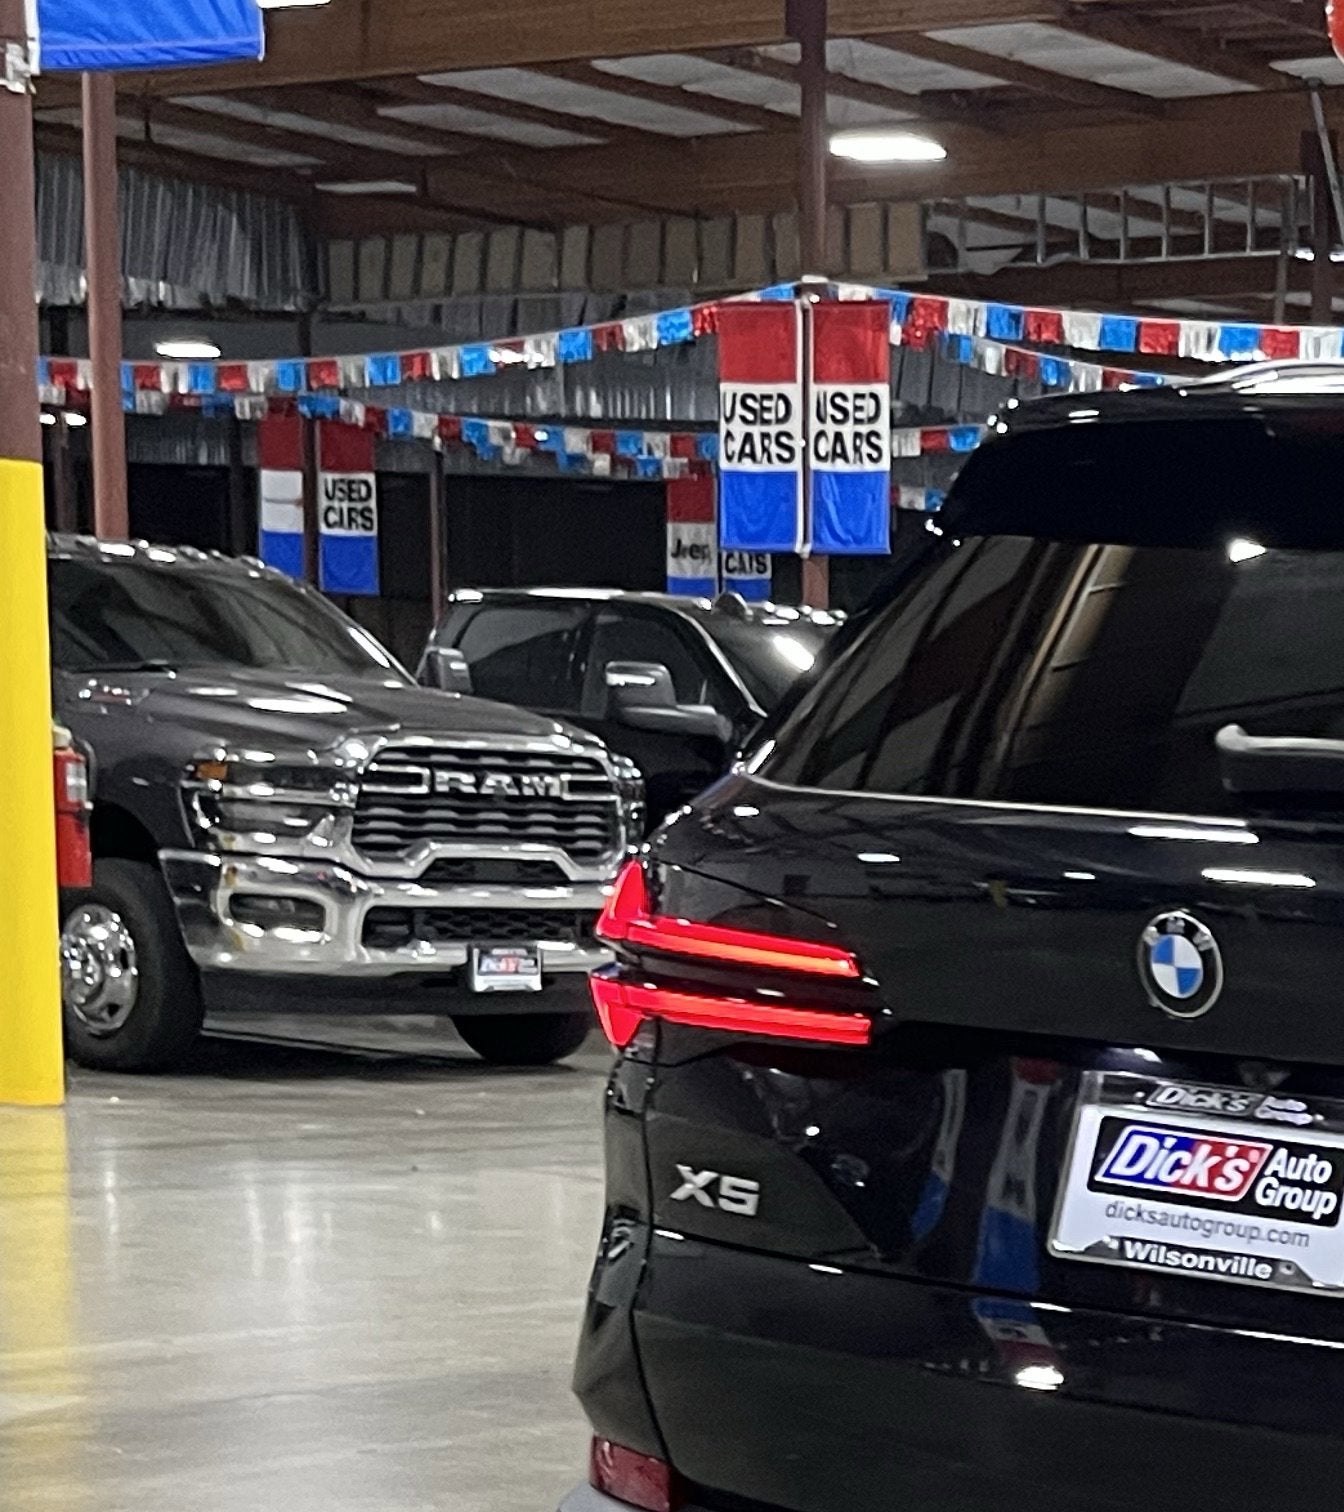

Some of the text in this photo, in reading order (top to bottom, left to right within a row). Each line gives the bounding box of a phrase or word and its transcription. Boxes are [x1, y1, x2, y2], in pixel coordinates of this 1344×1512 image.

[722, 391, 793, 425] USED
[815, 391, 882, 425] USED
[723, 429, 797, 465] CARS
[813, 429, 884, 465] CARS
[324, 477, 373, 503] USED
[434, 769, 562, 797] RAM
[1109, 1133, 1253, 1193] Dick's
[1263, 1147, 1333, 1184] Auto
[669, 1163, 761, 1217] X5
[1254, 1177, 1338, 1220] Group
[1104, 1199, 1311, 1248] dicksautogroup.com
[1121, 1239, 1274, 1280] Wilsonville
